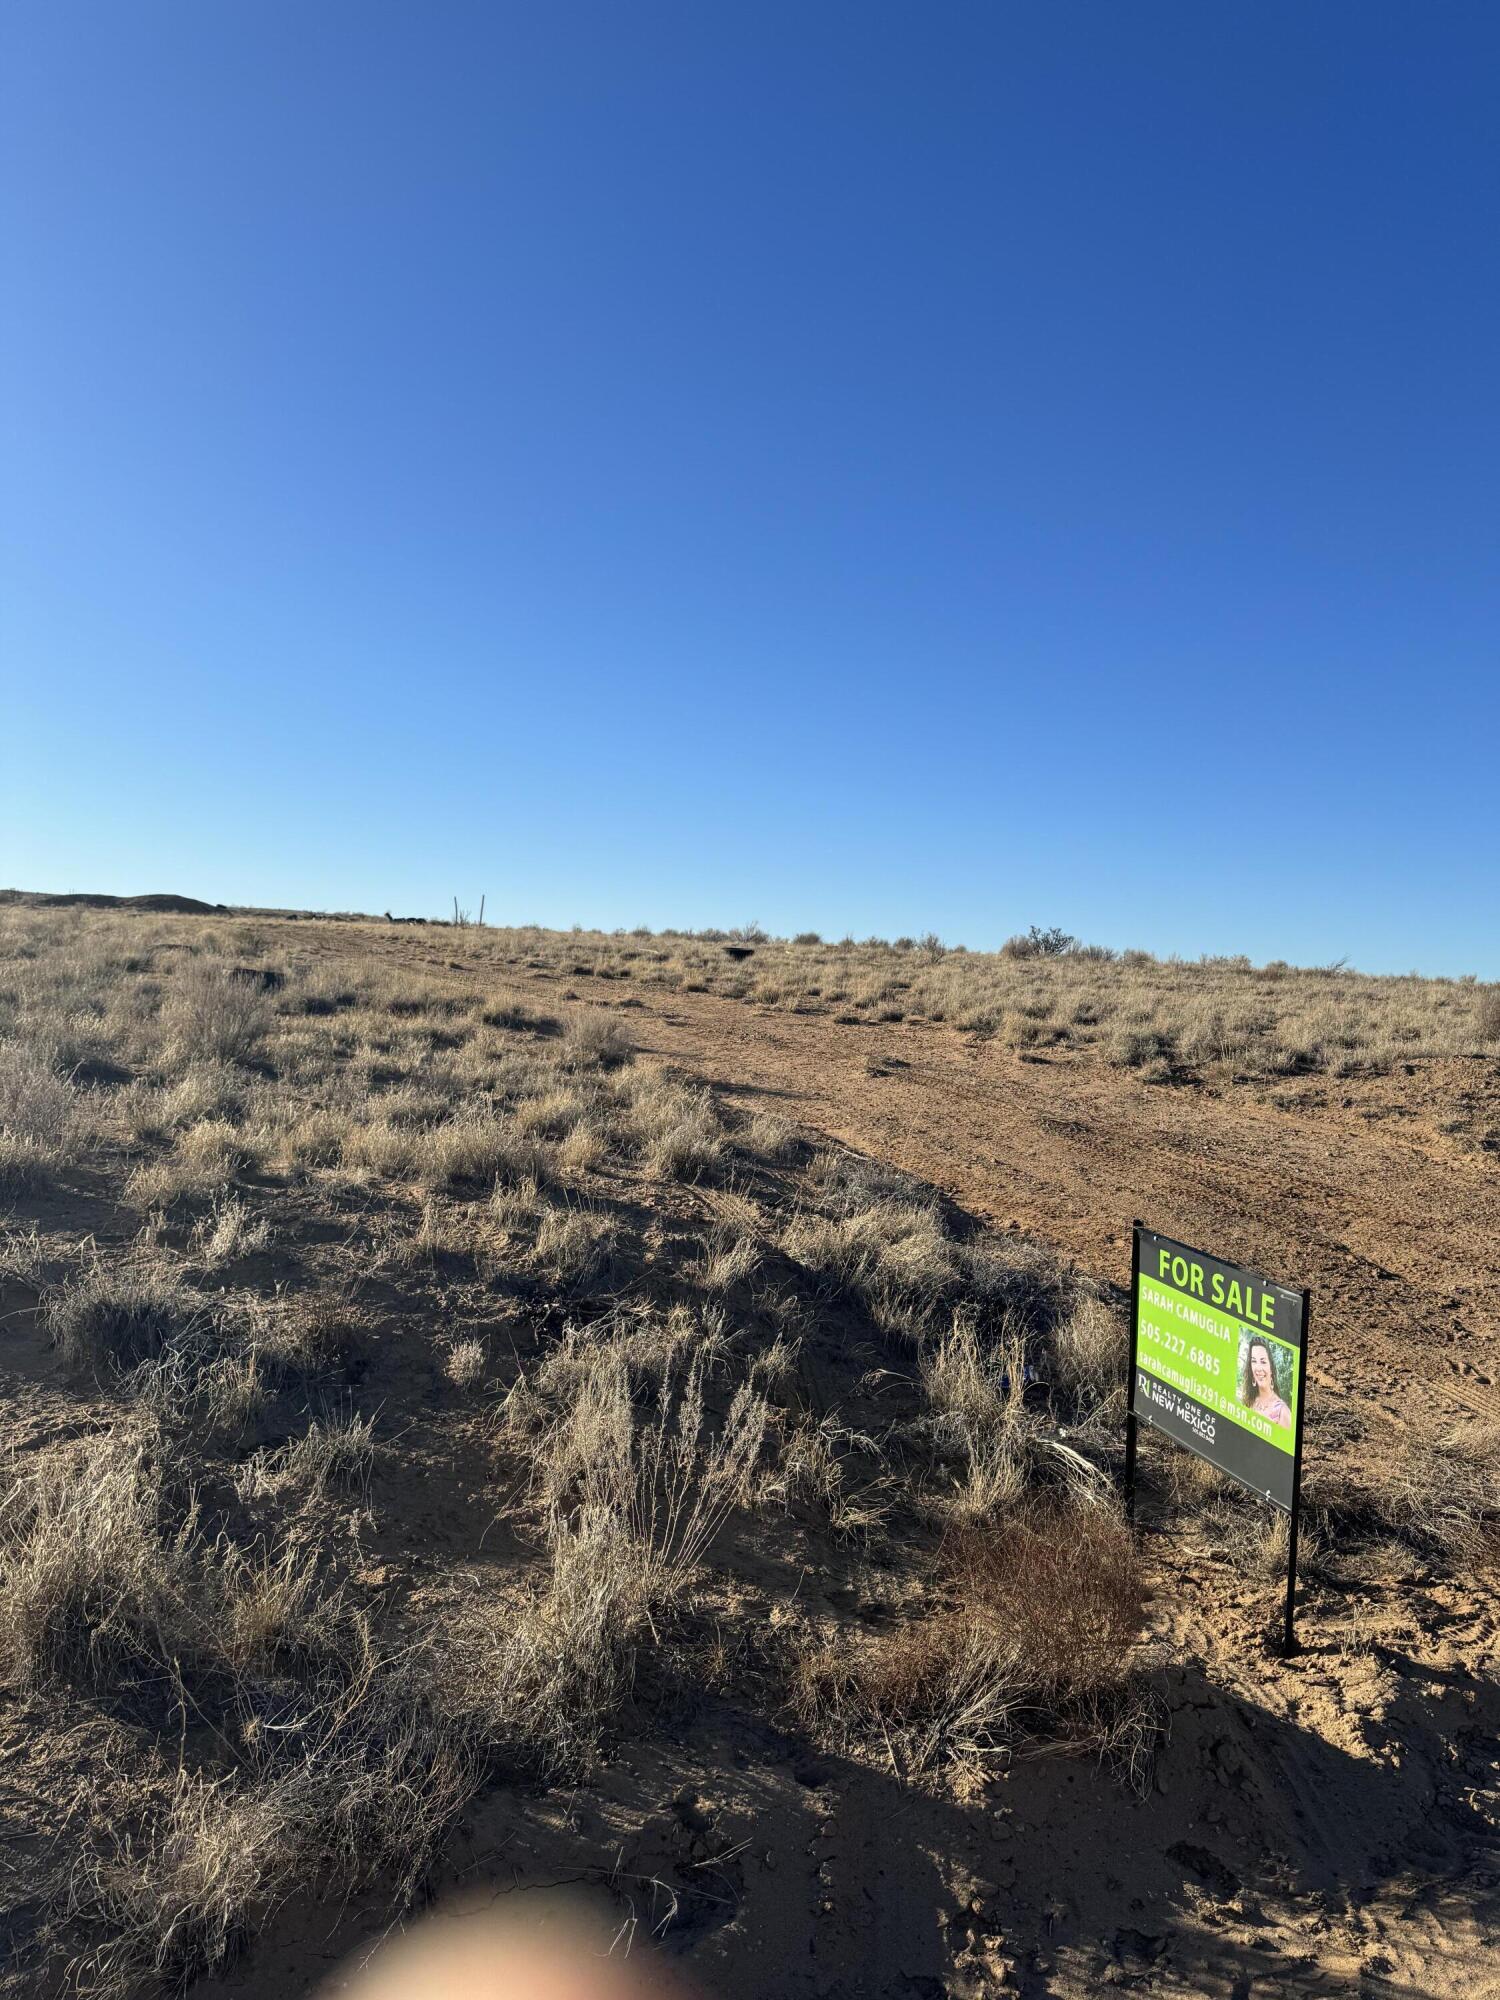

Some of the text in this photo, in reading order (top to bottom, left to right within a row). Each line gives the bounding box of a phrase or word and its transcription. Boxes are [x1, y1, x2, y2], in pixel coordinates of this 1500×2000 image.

[1142, 1285, 1231, 1342] SARAH CAMUGLIA
[1158, 1248, 1275, 1329] FOR SALE
[1140, 1319, 1220, 1376] 505.227.6885
[1138, 1352, 1273, 1437] sarahcamuglia291@msn.com
[1152, 1383, 1216, 1425] REALTY ONE OF
[1152, 1391, 1216, 1438] NEW MEXICO
